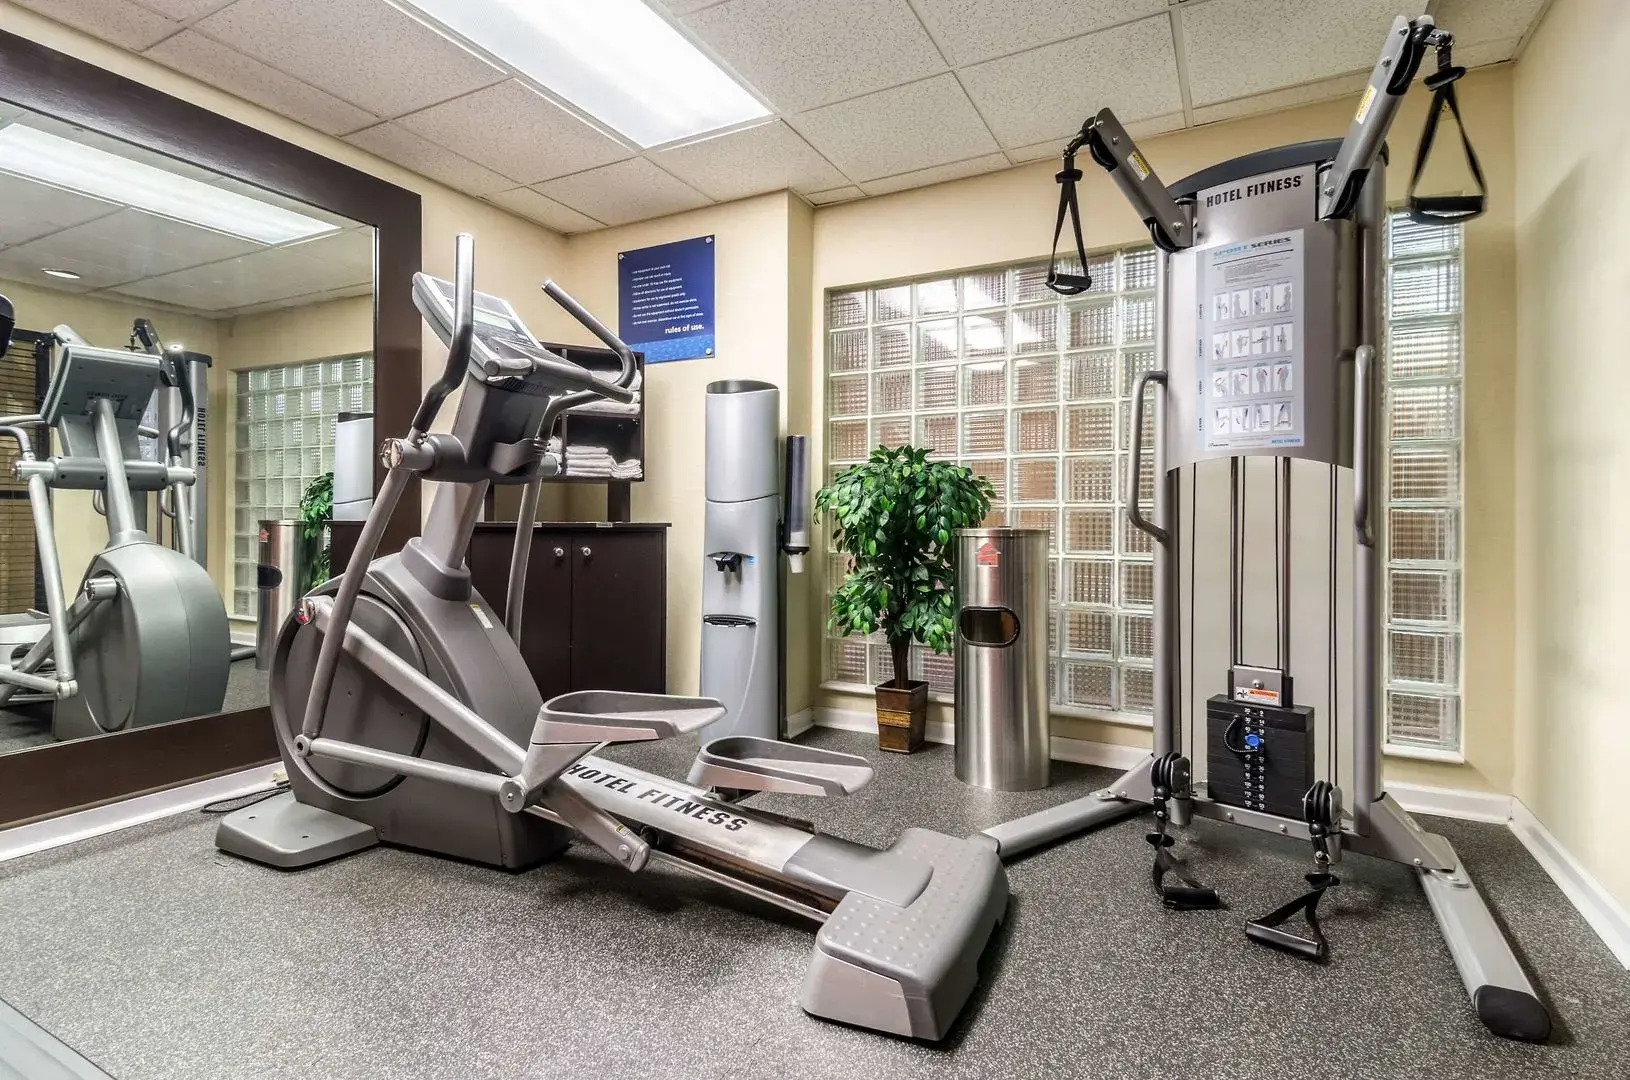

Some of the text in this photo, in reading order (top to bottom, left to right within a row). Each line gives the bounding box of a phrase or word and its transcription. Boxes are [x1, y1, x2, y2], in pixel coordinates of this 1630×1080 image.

[1206, 175, 1302, 208] HOTEL FITNESS
[665, 325, 681, 334] rules
[682, 323, 690, 332] of
[568, 764, 748, 831] HOTEL FITNESS
